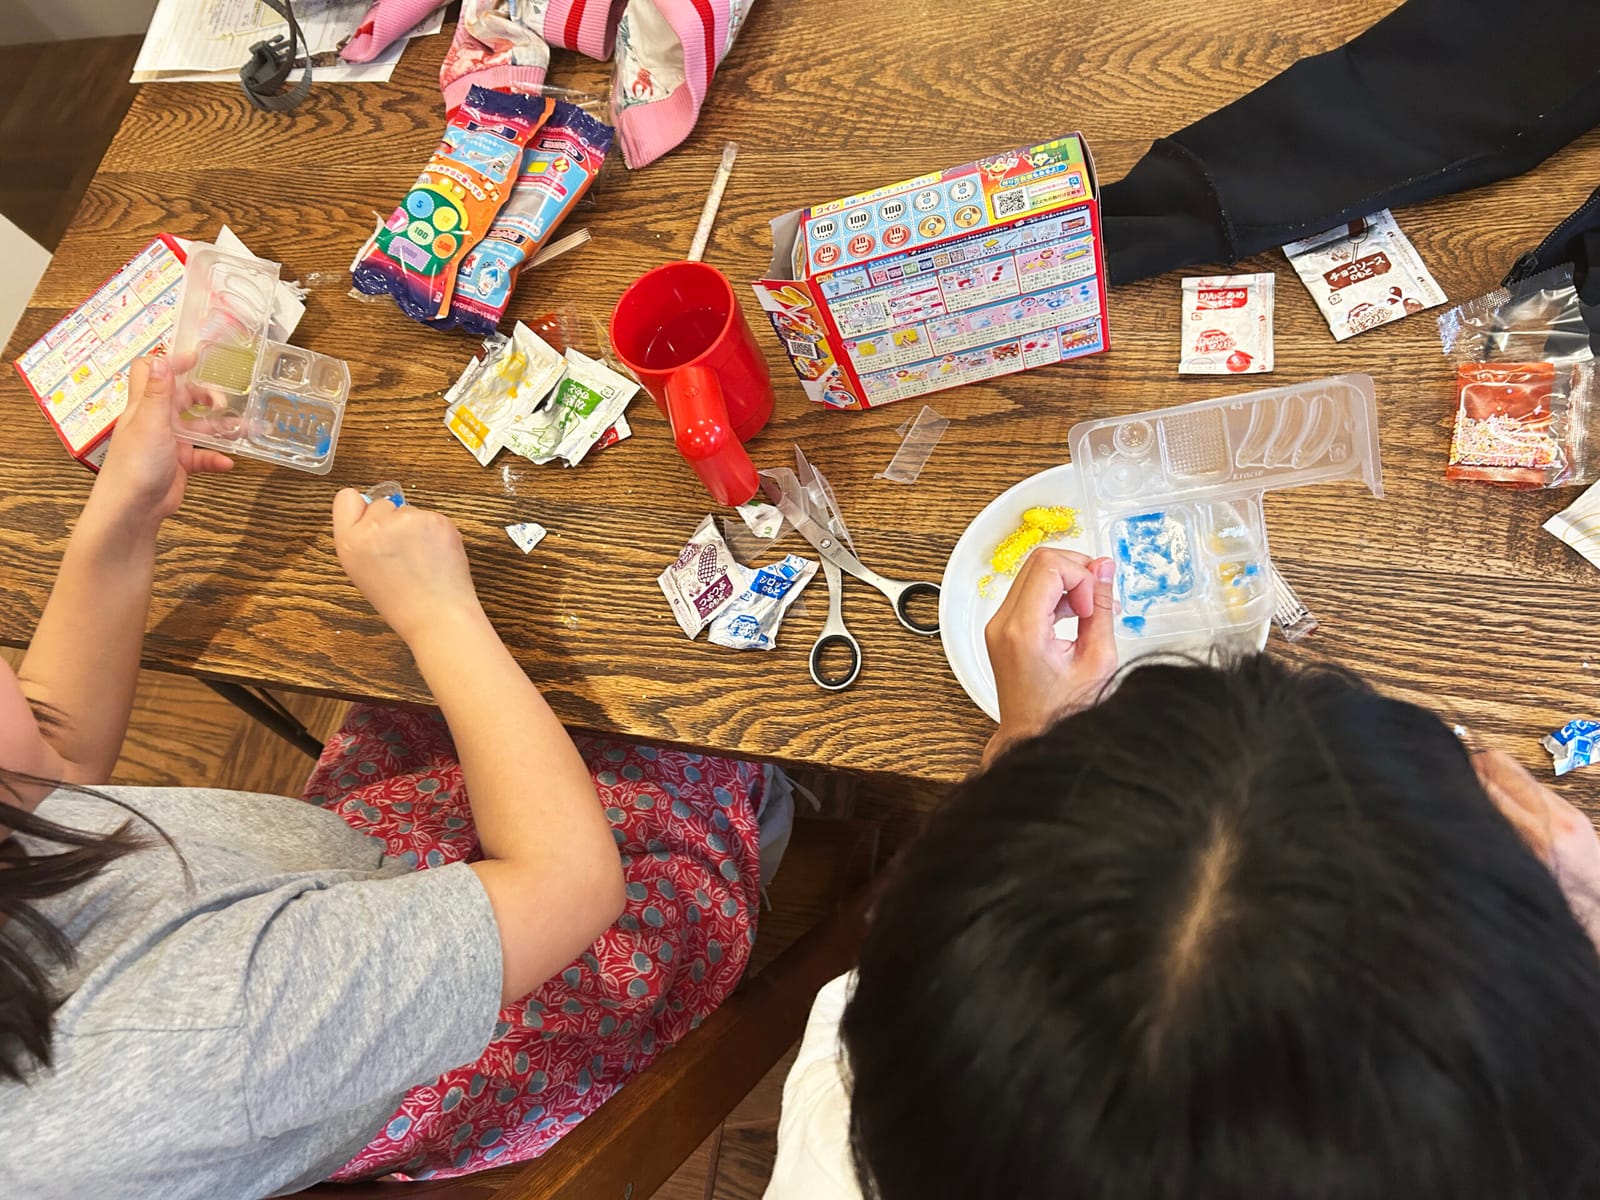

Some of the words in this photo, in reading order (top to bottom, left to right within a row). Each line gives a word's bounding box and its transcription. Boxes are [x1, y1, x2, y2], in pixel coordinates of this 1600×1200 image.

[416, 200, 424, 208] 5
[816, 204, 839, 214] コイン
[884, 204, 901, 216] 100
[850, 213, 867, 225] 100
[414, 226, 429, 240] 100
[816, 223, 833, 235] 100
[891, 227, 901, 236] 10
[856, 237, 866, 245] 10
[822, 246, 832, 254] 10
[1329, 255, 1386, 282] チョコソース
[1350, 268, 1374, 281] のもと
[1199, 291, 1245, 300] りんごあめ
[759, 575, 791, 590] シロップ
[699, 578, 726, 605] つぶつぶ
[762, 586, 780, 596] のもと
